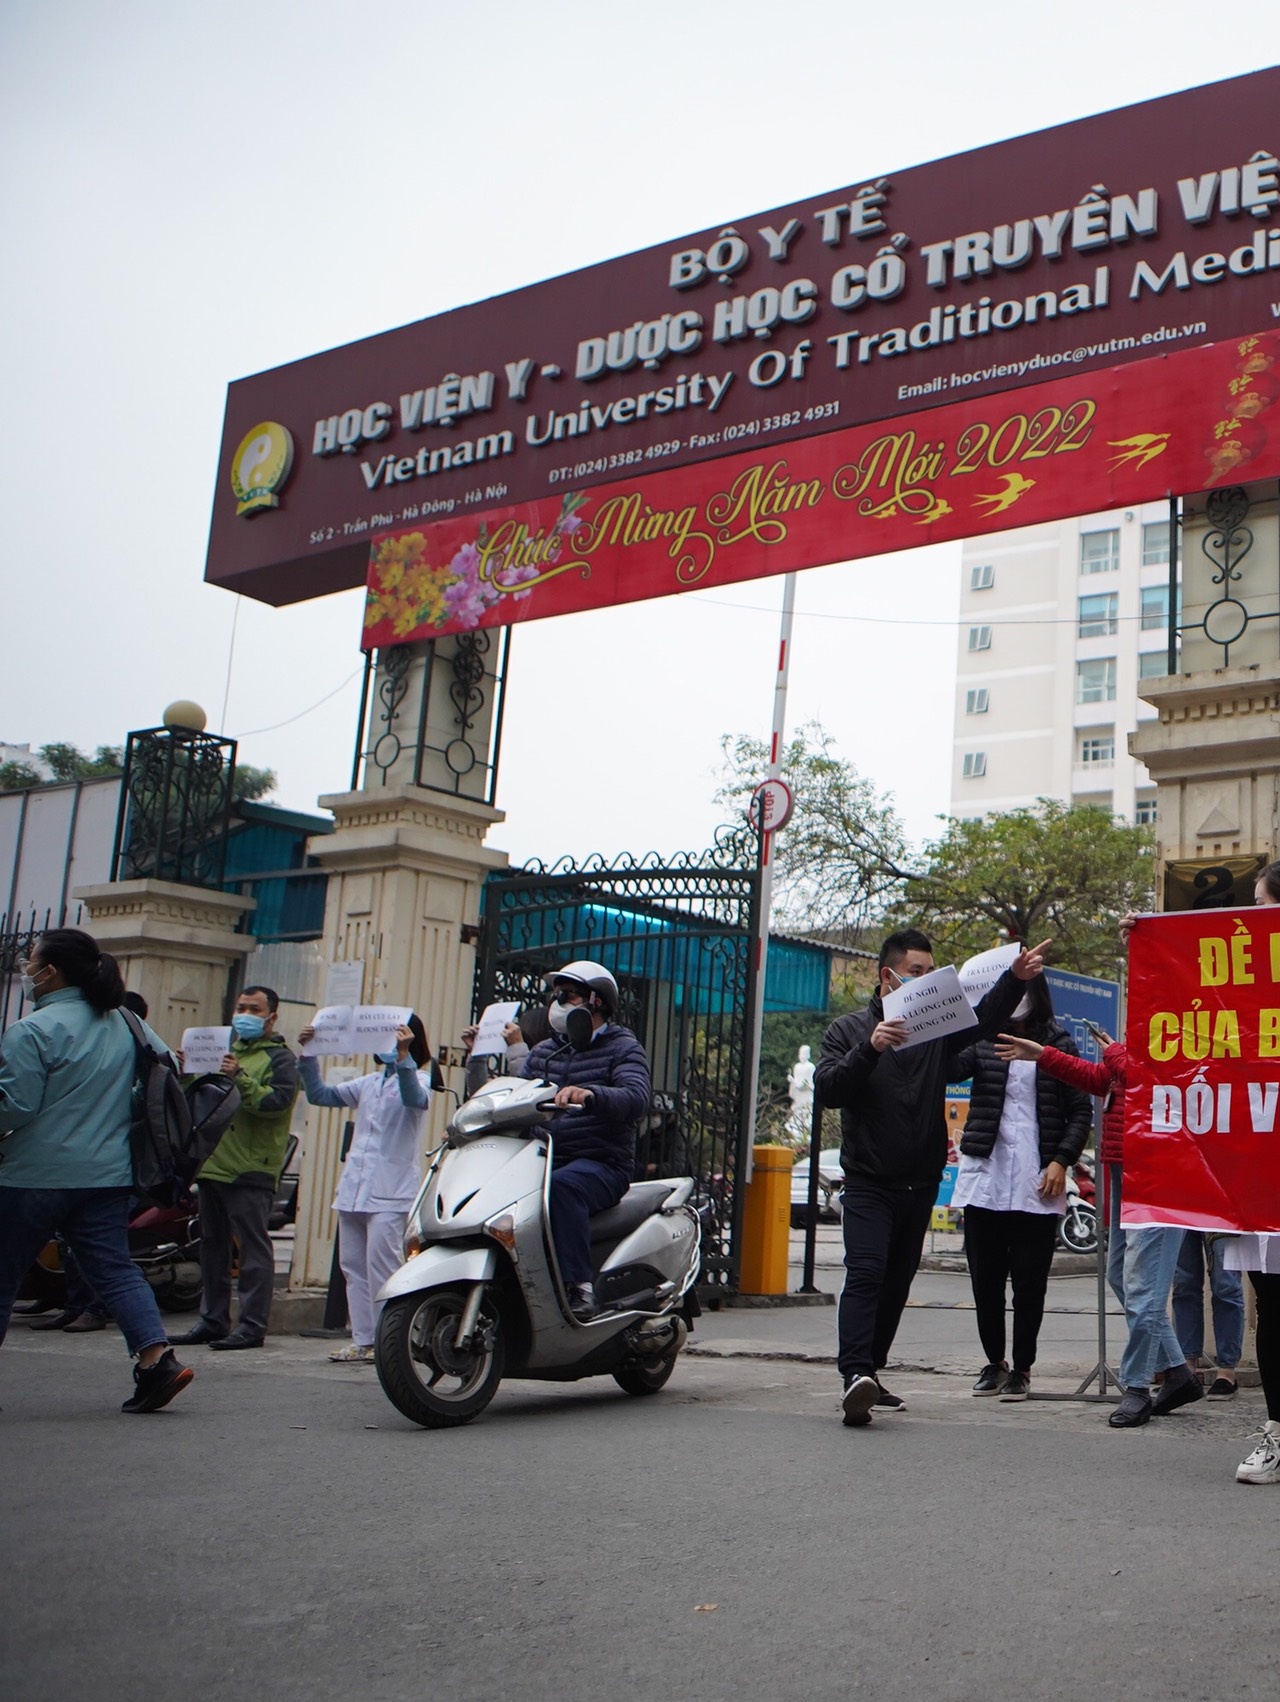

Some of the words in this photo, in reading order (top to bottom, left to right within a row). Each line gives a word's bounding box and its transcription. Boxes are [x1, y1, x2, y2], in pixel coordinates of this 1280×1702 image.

[669, 228, 749, 289] BỘ
[758, 218, 801, 260] Y
[814, 178, 894, 246] TẾ
[312, 401, 392, 457] HỌC
[399, 373, 494, 431] VIỆN
[504, 357, 536, 399] Y
[575, 309, 703, 379] DƯỢC
[713, 278, 818, 342] HỌC
[830, 231, 912, 311] CỔ
[920, 183, 1160, 290] TRUYỀN
[360, 429, 514, 491] Vietnam
[525, 370, 736, 445] University
[748, 340, 812, 388] Of
[827, 266, 1110, 368] Traditional
[898, 376, 948, 400] Email:
[950, 319, 1207, 389] hocvienyduoc@vutm.edu.vn
[574, 459, 608, 478] (024)
[609, 449, 643, 468] 3382
[644, 440, 680, 458] 4929
[689, 431, 721, 449] Fax:
[723, 422, 760, 442] (024)
[762, 411, 801, 431] 3382
[804, 400, 840, 422] 4931
[477, 520, 592, 593] Chúc
[571, 493, 715, 584] Mừng
[706, 460, 824, 545] Năm
[832, 430, 946, 517] Mới
[949, 400, 1098, 477] 2022
[1193, 866, 1235, 909] 2
[963, 984, 975, 993] HO
[1198, 918, 1255, 986] ĐỀ
[1147, 999, 1241, 1063] CỦA
[1150, 1066, 1231, 1134] ĐỐI
